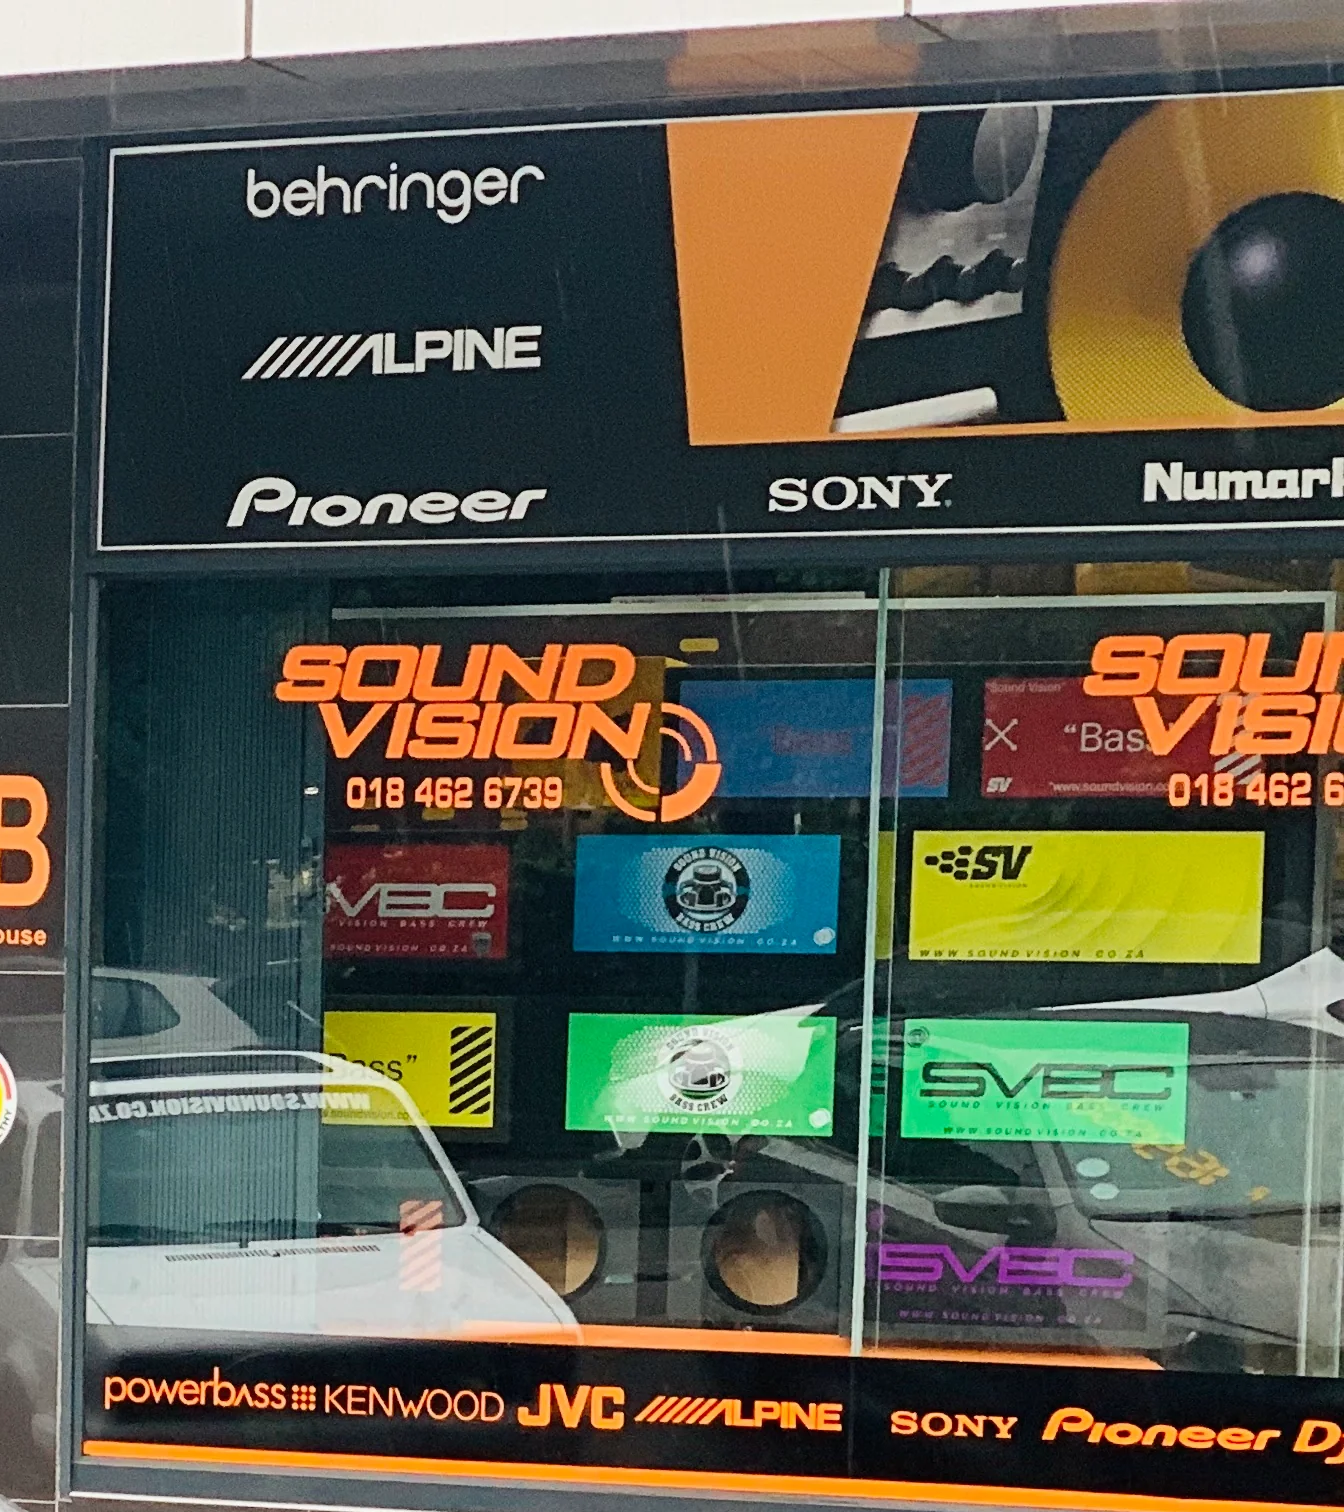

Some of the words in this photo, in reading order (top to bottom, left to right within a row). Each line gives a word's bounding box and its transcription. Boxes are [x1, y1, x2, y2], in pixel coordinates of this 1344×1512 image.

[246, 162, 544, 224] behringer
[341, 326, 542, 378] ALPINE
[227, 477, 546, 529] Pioneer
[768, 474, 952, 513] SONY
[275, 644, 636, 703] SOUND
[320, 702, 652, 760] VISION
[1133, 695, 1344, 756] VISI
[346, 776, 404, 809] 018
[414, 776, 474, 809] 462
[483, 776, 562, 809] 6739
[1168, 772, 1234, 807] 018
[1246, 772, 1312, 807] 462
[970, 845, 1033, 880] SV
[105, 1366, 286, 1410] powerbass
[324, 1384, 503, 1421] KENWOOD
[517, 1384, 624, 1430] JVC
[707, 1399, 842, 1432] ALPINE
[891, 1410, 1017, 1440] SONY
[1042, 1407, 1282, 1451] Pioneer
